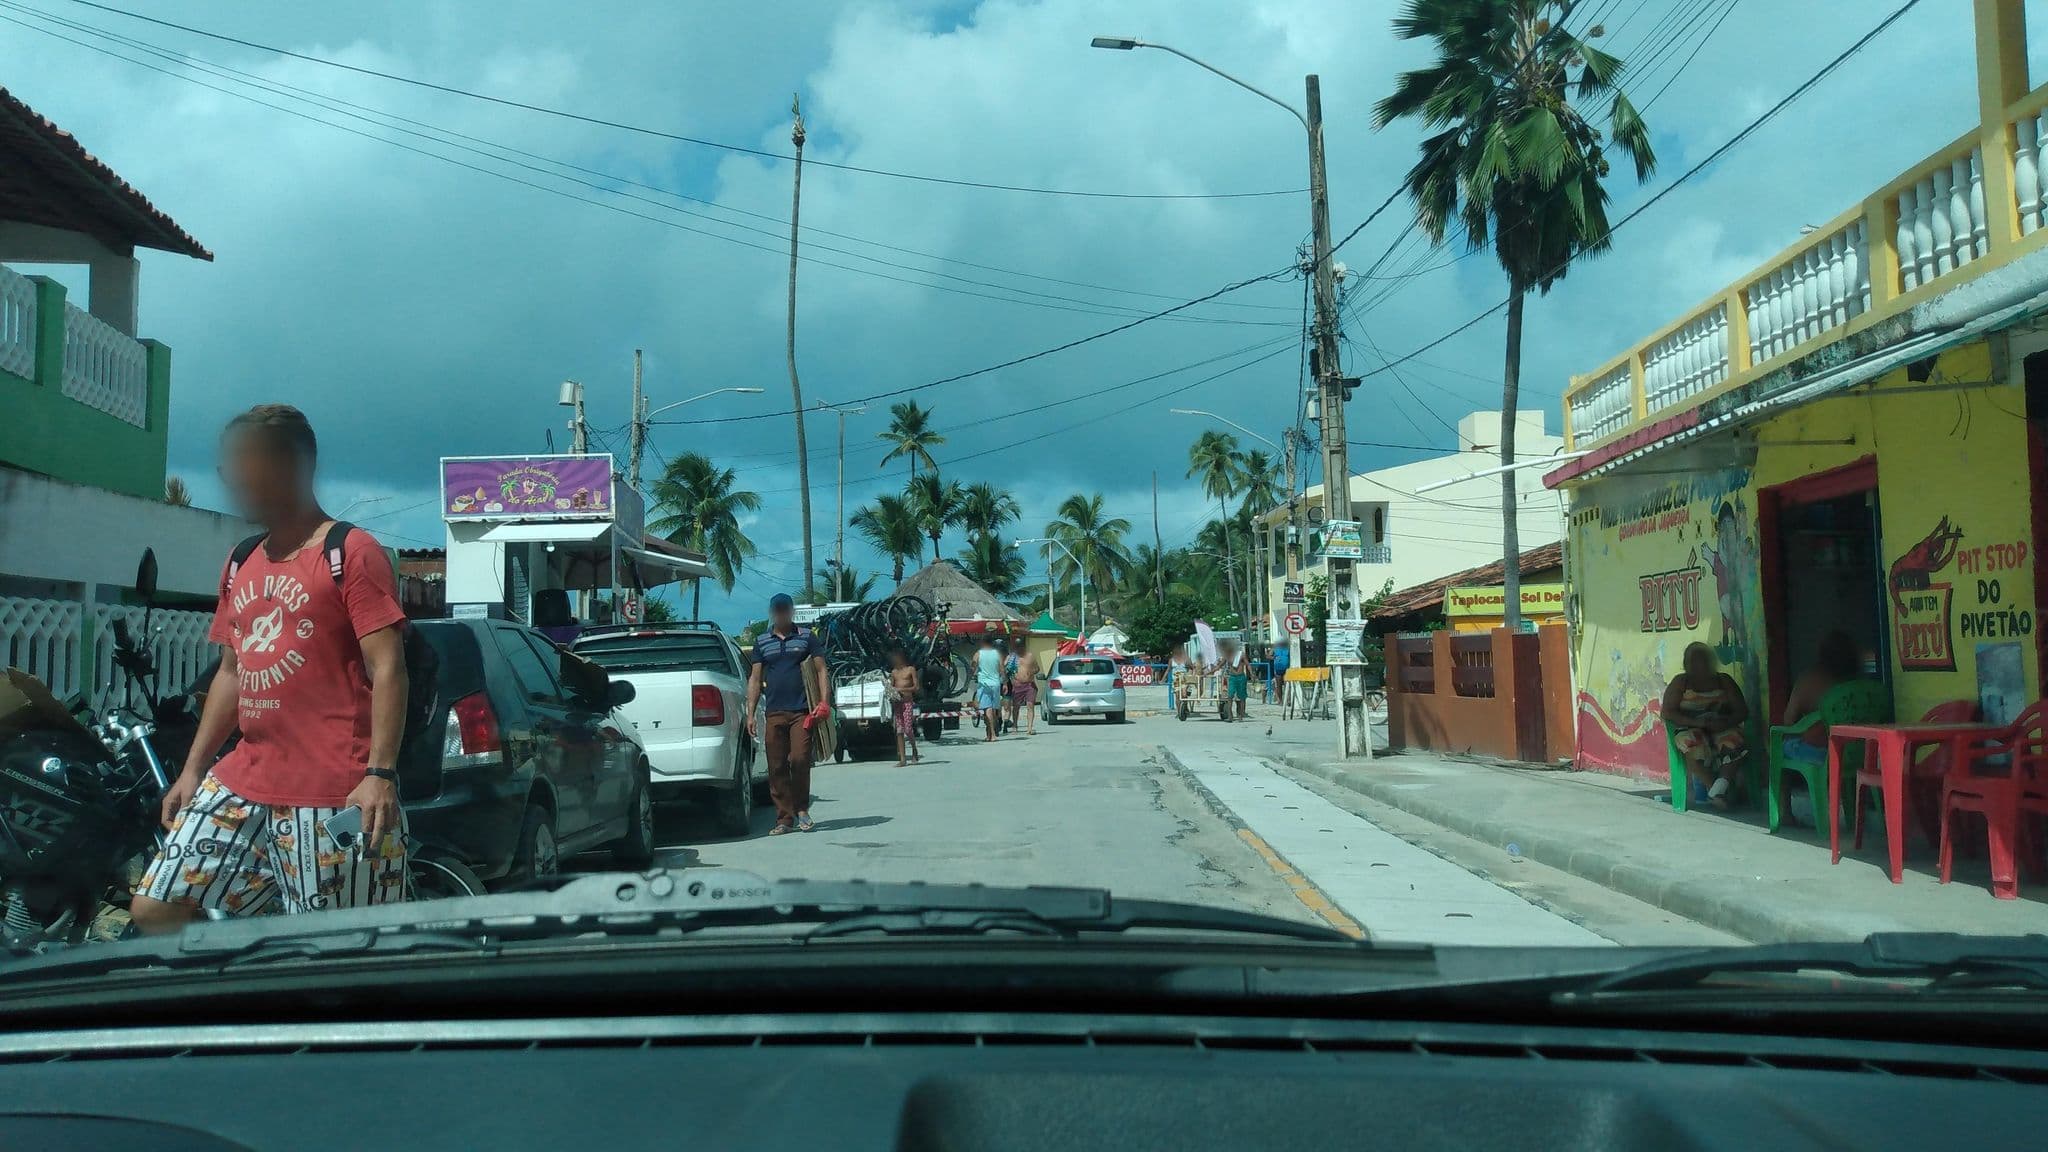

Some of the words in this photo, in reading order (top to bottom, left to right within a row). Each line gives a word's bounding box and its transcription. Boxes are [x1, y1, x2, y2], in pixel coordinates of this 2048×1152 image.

[1957, 547, 1982, 575] PIT
[1985, 540, 2028, 572] STOP
[233, 580, 259, 614] ALL
[263, 575, 310, 613] DRESS
[1521, 591, 1542, 604] Sol
[1639, 545, 1702, 633] PITÚ
[1977, 579, 2001, 604] DO
[1924, 595, 1938, 612] TEM
[1960, 603, 2032, 638] PIVETÃO
[1900, 613, 1943, 659] PITÚ
[1121, 665, 1146, 674] COCO
[1122, 674, 1152, 684] GELADO
[255, 699, 281, 709] SERIES
[165, 837, 216, 861] D&G
[728, 887, 772, 898] BOSCH
